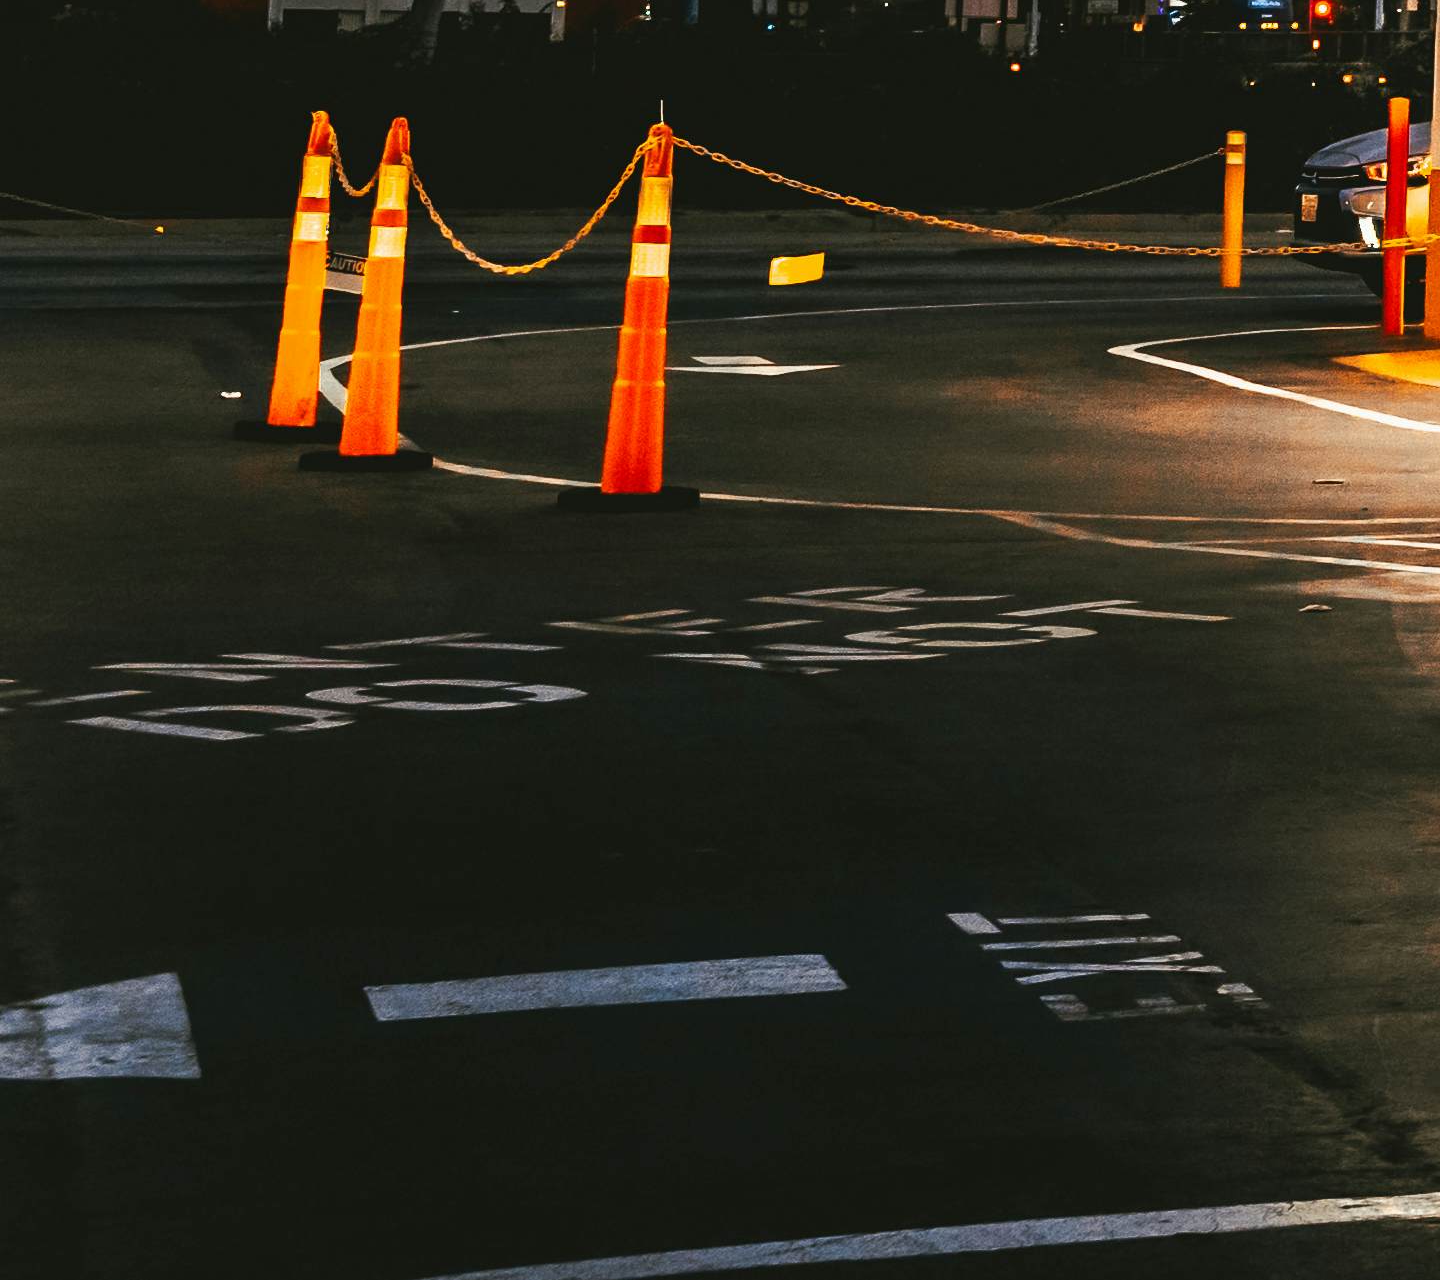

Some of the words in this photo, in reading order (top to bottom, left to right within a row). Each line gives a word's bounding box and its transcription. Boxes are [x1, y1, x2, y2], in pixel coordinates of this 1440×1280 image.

[65, 677, 589, 742] DO
[650, 598, 1234, 675] NOT
[945, 912, 1270, 1022] EXIT
